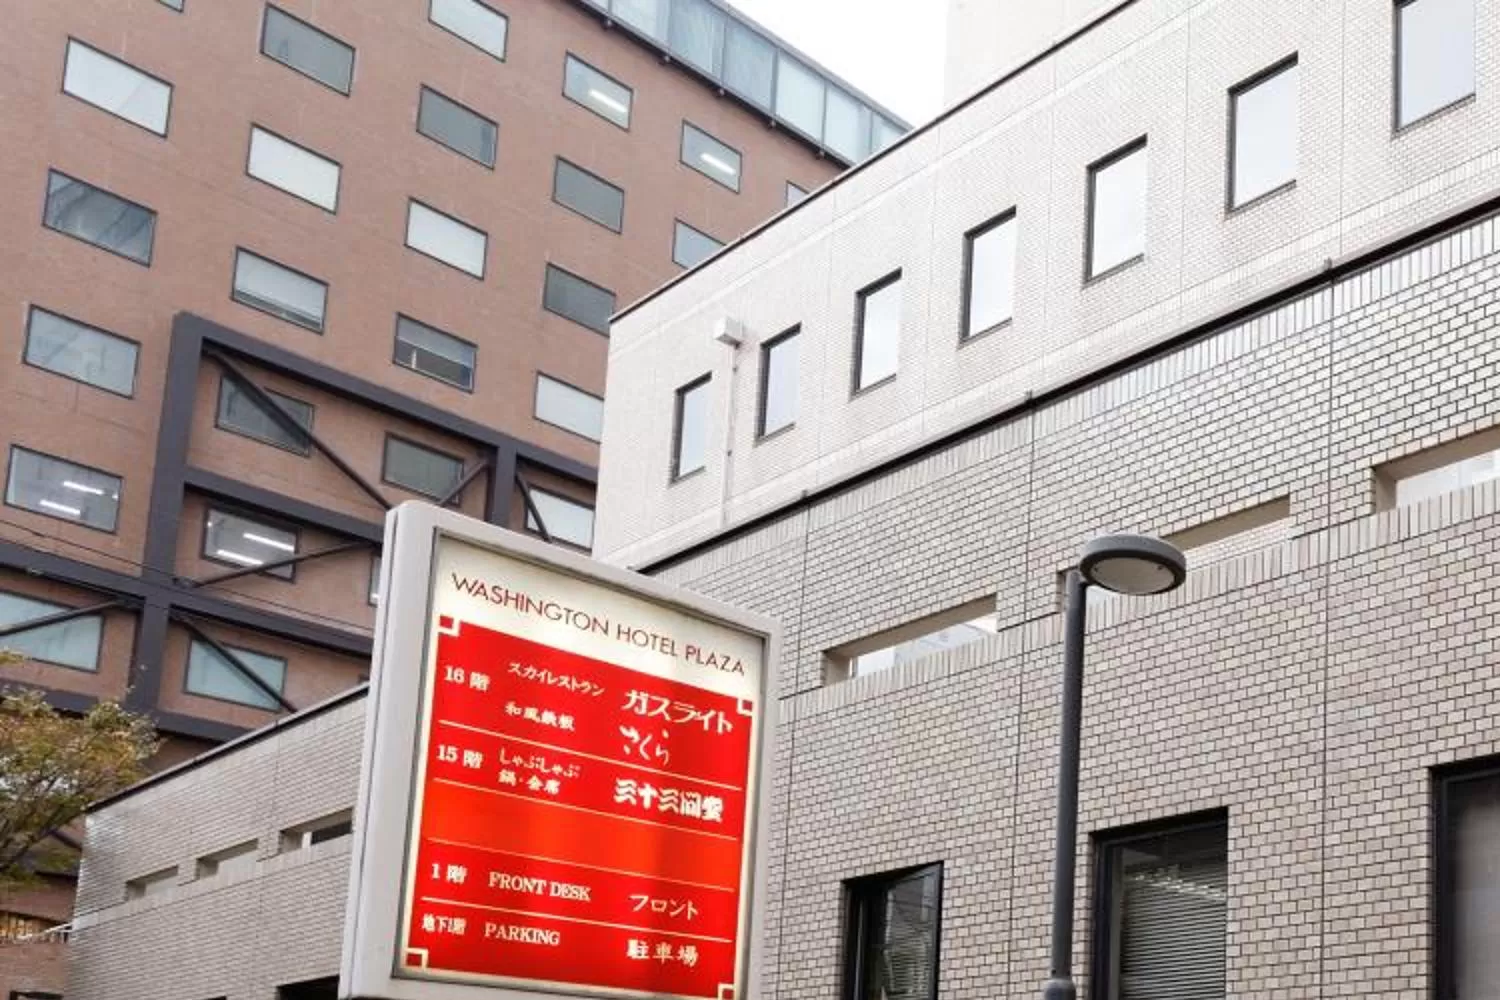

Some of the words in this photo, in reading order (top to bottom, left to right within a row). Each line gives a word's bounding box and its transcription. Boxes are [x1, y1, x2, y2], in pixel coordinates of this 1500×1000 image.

[451, 573, 610, 637] WASHINGTON
[616, 623, 679, 657] HOTEL
[685, 644, 746, 677] PLAZA
[508, 661, 605, 697] スカイレストラン
[620, 689, 734, 735] ガスライト
[619, 725, 670, 766] さくら
[488, 870, 547, 896] FRONT
[549, 880, 592, 902] DESK
[629, 893, 699, 921] フロント
[484, 921, 561, 946] PARKING
[626, 938, 699, 967] 駐車場
